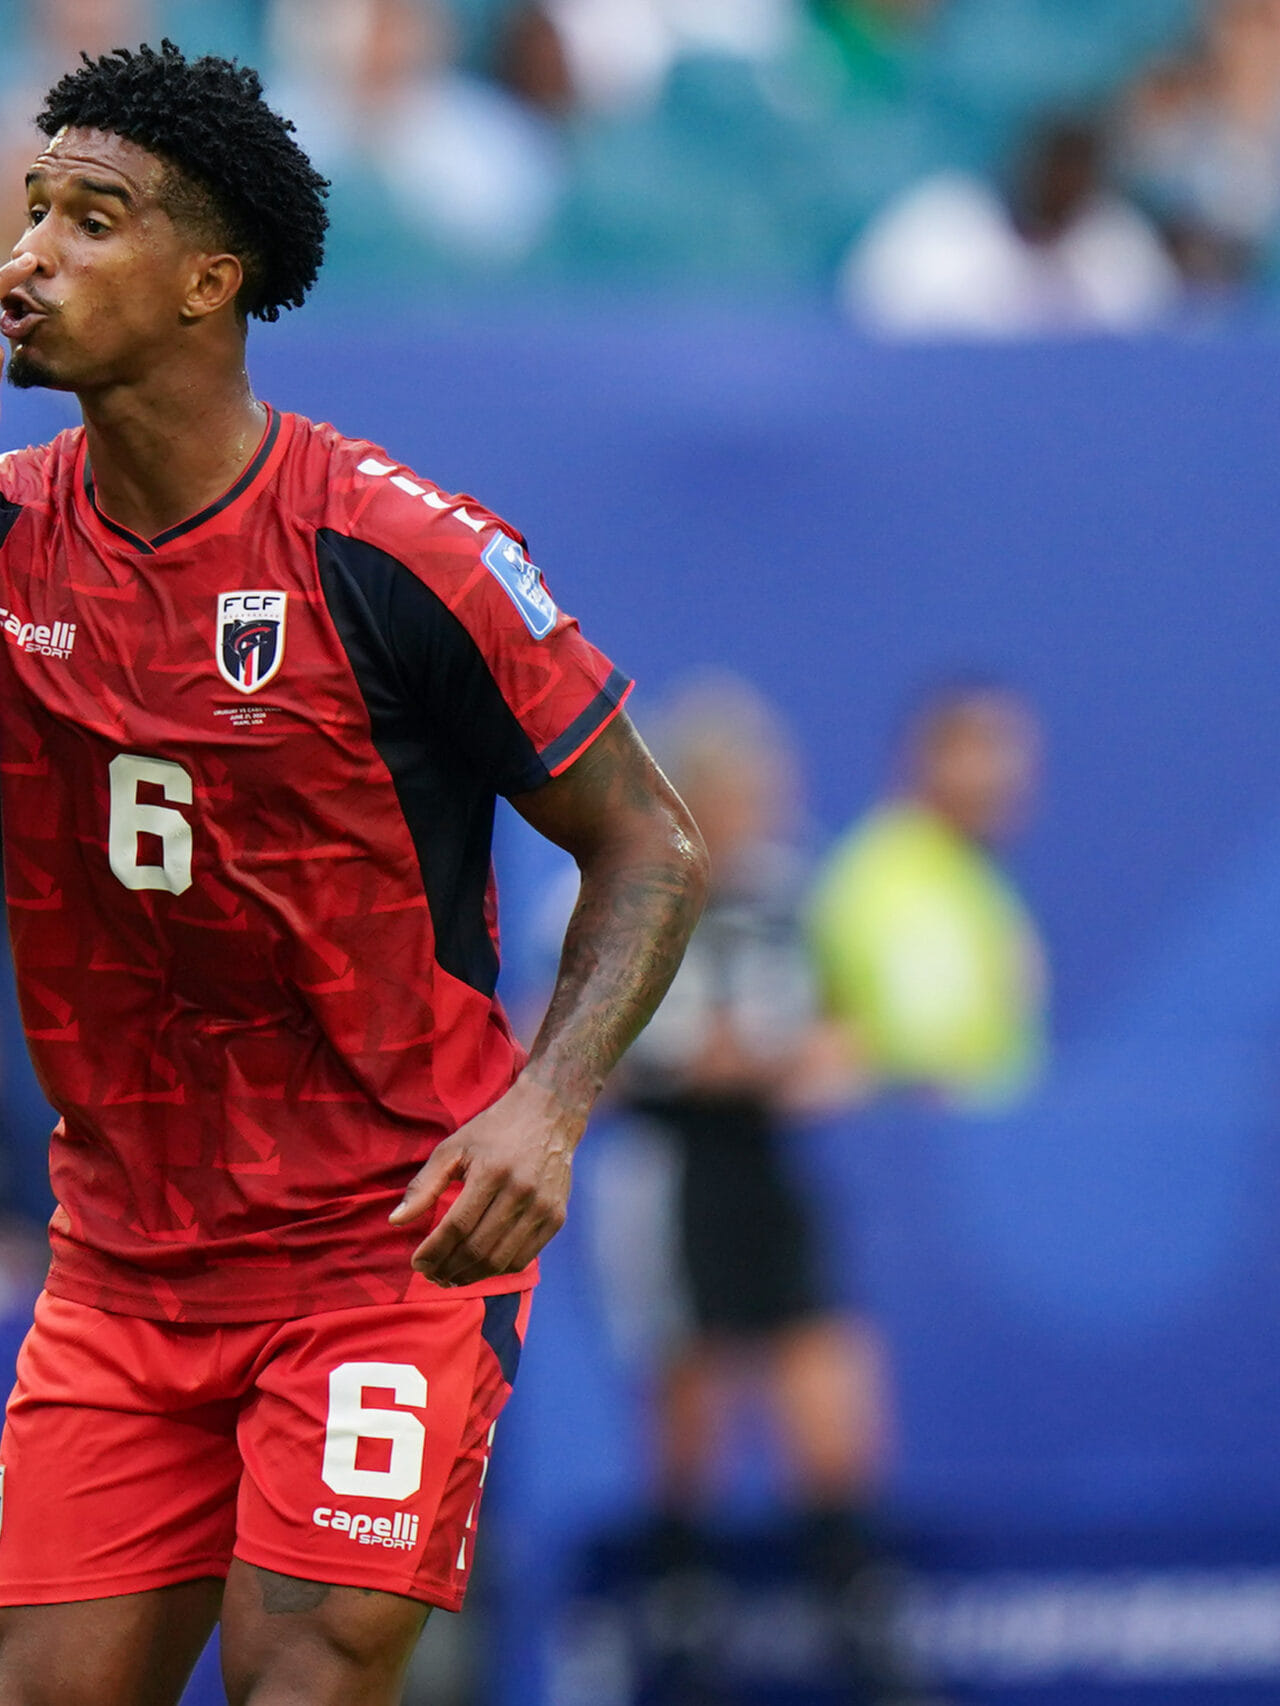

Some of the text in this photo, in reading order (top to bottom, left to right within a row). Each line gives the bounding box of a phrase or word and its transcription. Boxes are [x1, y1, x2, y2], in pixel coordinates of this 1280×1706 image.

[224, 596, 280, 612] FCF
[25, 643, 72, 660] SPORT
[109, 753, 193, 896] 6
[321, 1362, 428, 1501] 6
[312, 1507, 420, 1541] capelli
[358, 1533, 417, 1551] SPORT
